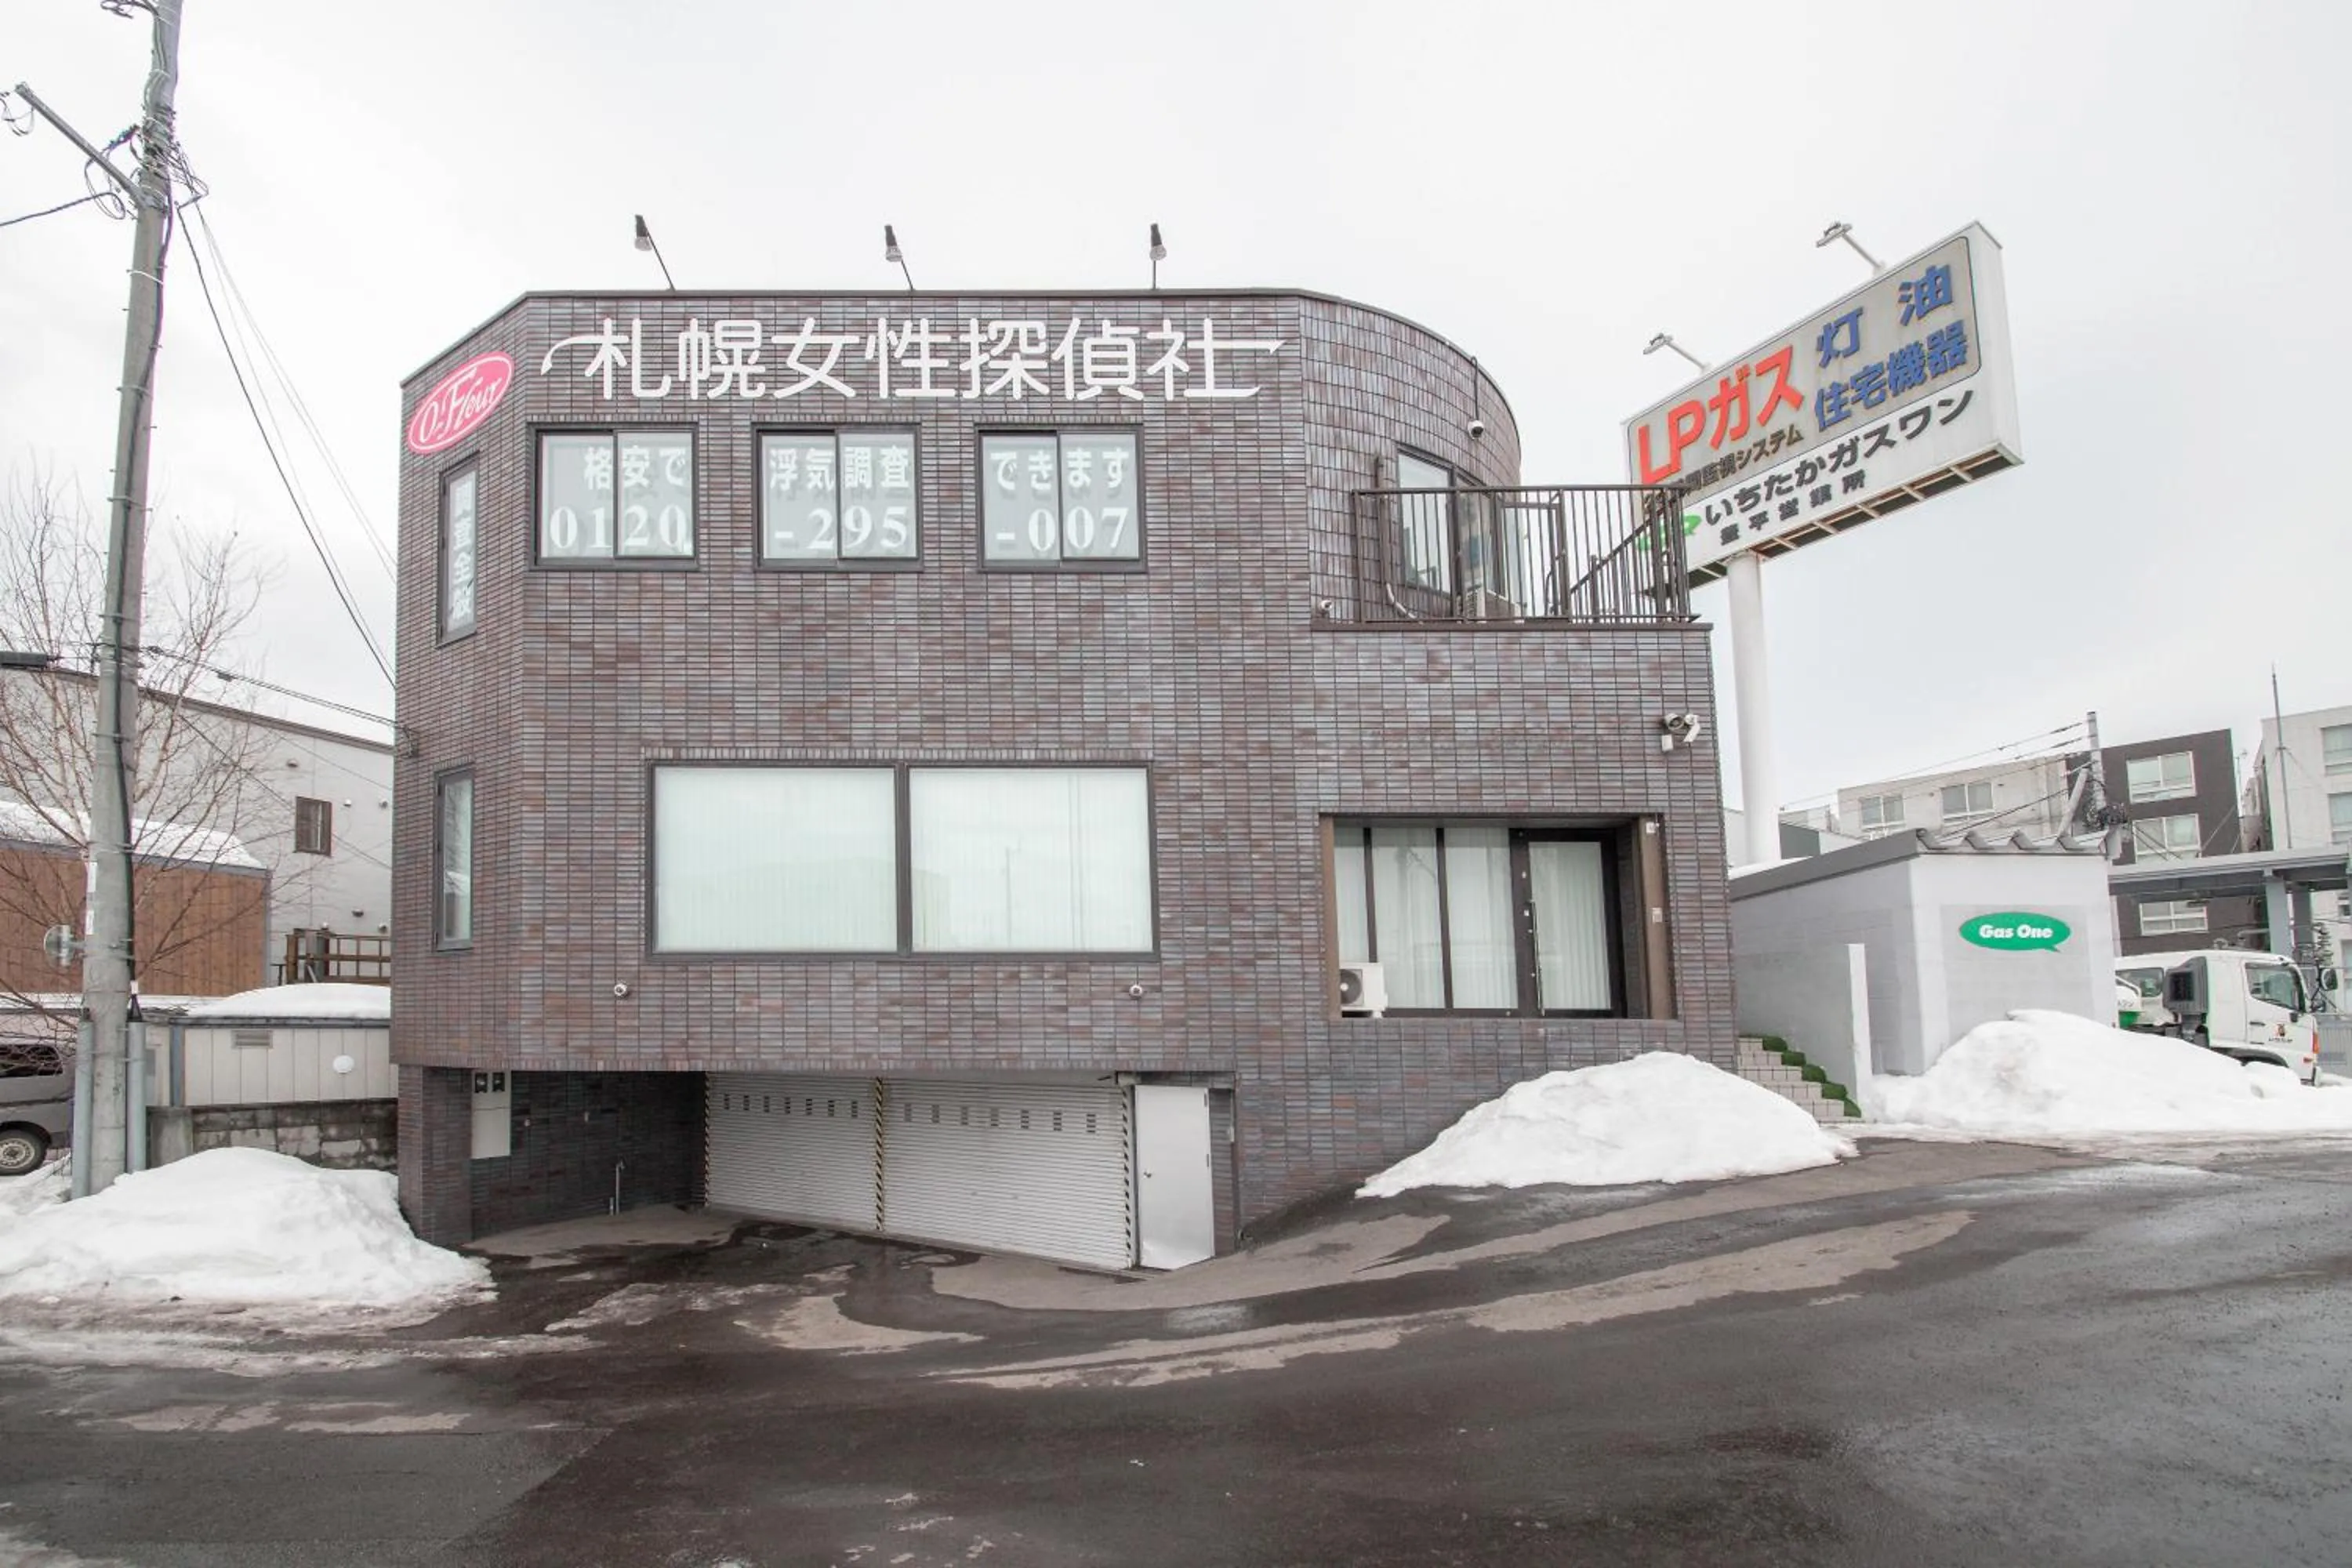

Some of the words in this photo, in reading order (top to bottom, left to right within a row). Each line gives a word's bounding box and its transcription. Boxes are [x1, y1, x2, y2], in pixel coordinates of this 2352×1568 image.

[541, 317, 1286, 400] 札幌女性探偵社
[1816, 264, 1953, 369] 灯油
[1637, 345, 1804, 486] LPガス
[1814, 319, 1968, 433] 住宅機器
[584, 445, 687, 490] 格安で
[769, 445, 909, 491] 浮気調査
[990, 448, 1130, 491] できます
[1704, 390, 1974, 526] いちたかガスワン
[550, 504, 688, 549] 0120
[1979, 924, 2014, 939] Gas
[2016, 923, 2054, 939] One
